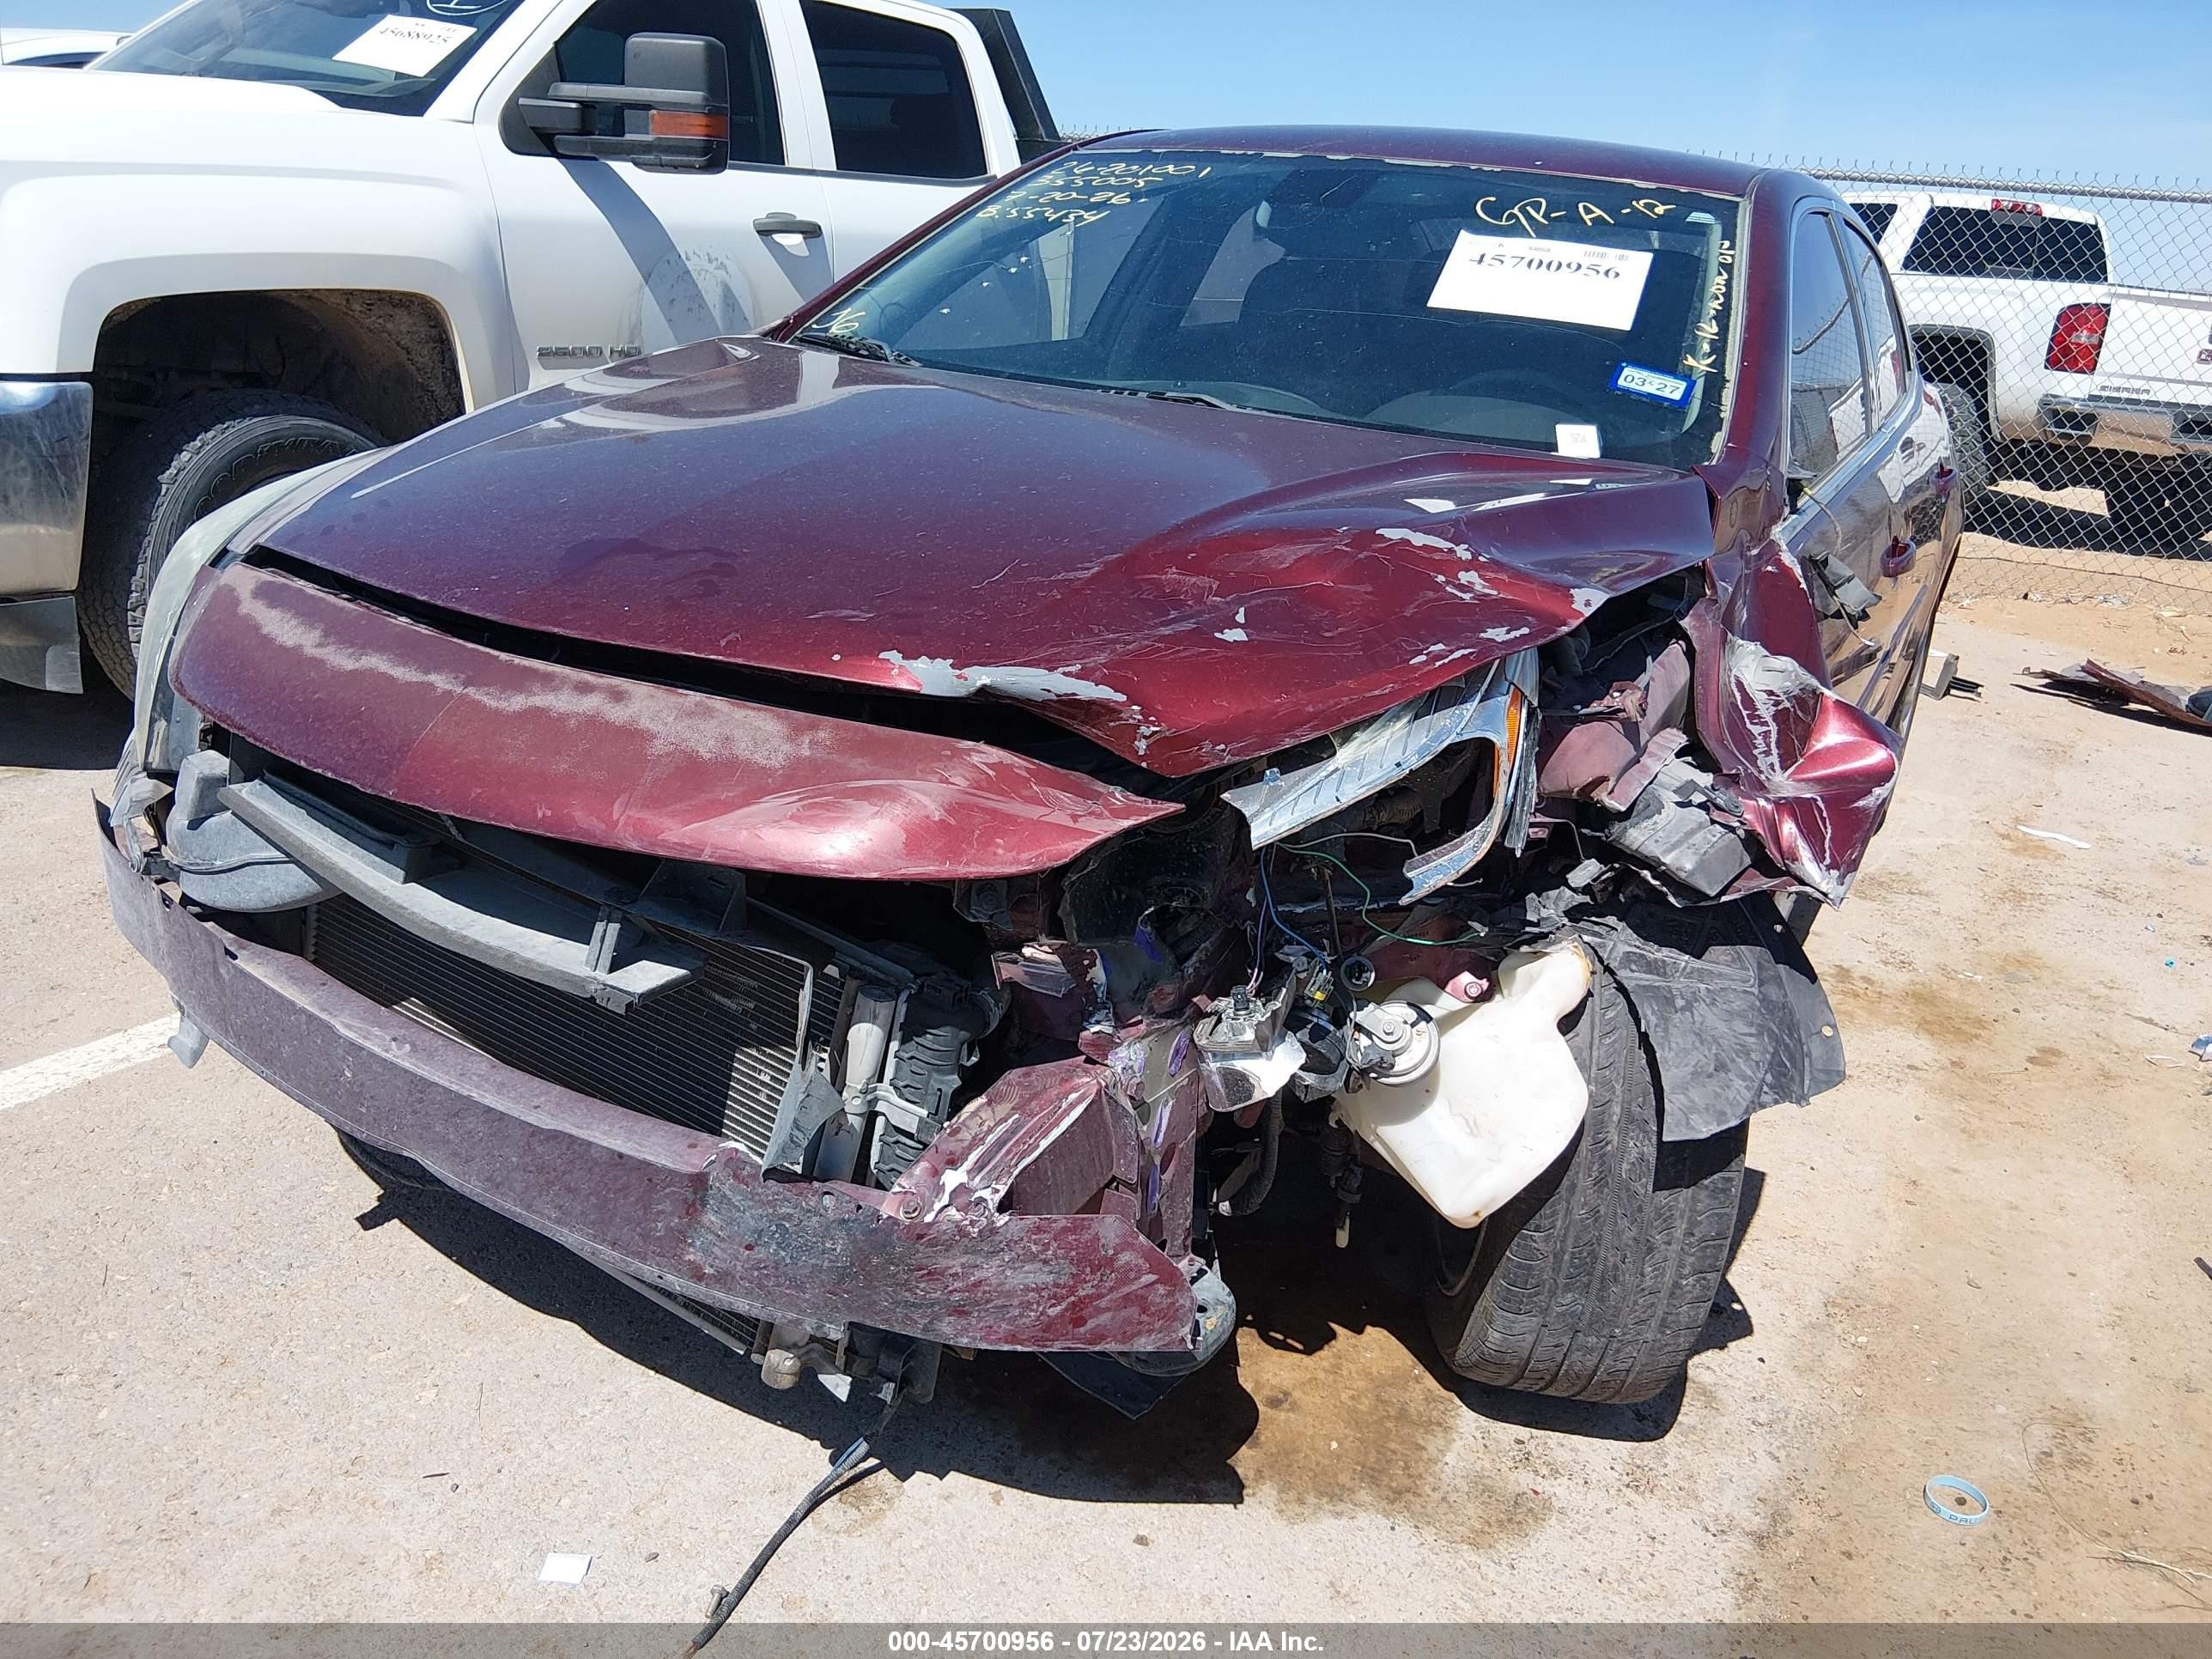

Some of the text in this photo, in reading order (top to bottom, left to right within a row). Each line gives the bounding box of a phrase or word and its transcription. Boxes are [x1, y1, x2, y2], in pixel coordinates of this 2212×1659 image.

[1468, 252, 1620, 279] 45700956
[535, 344, 603, 358] 2500
[1623, 374, 1647, 387] 03
[1656, 382, 1680, 395] 27
